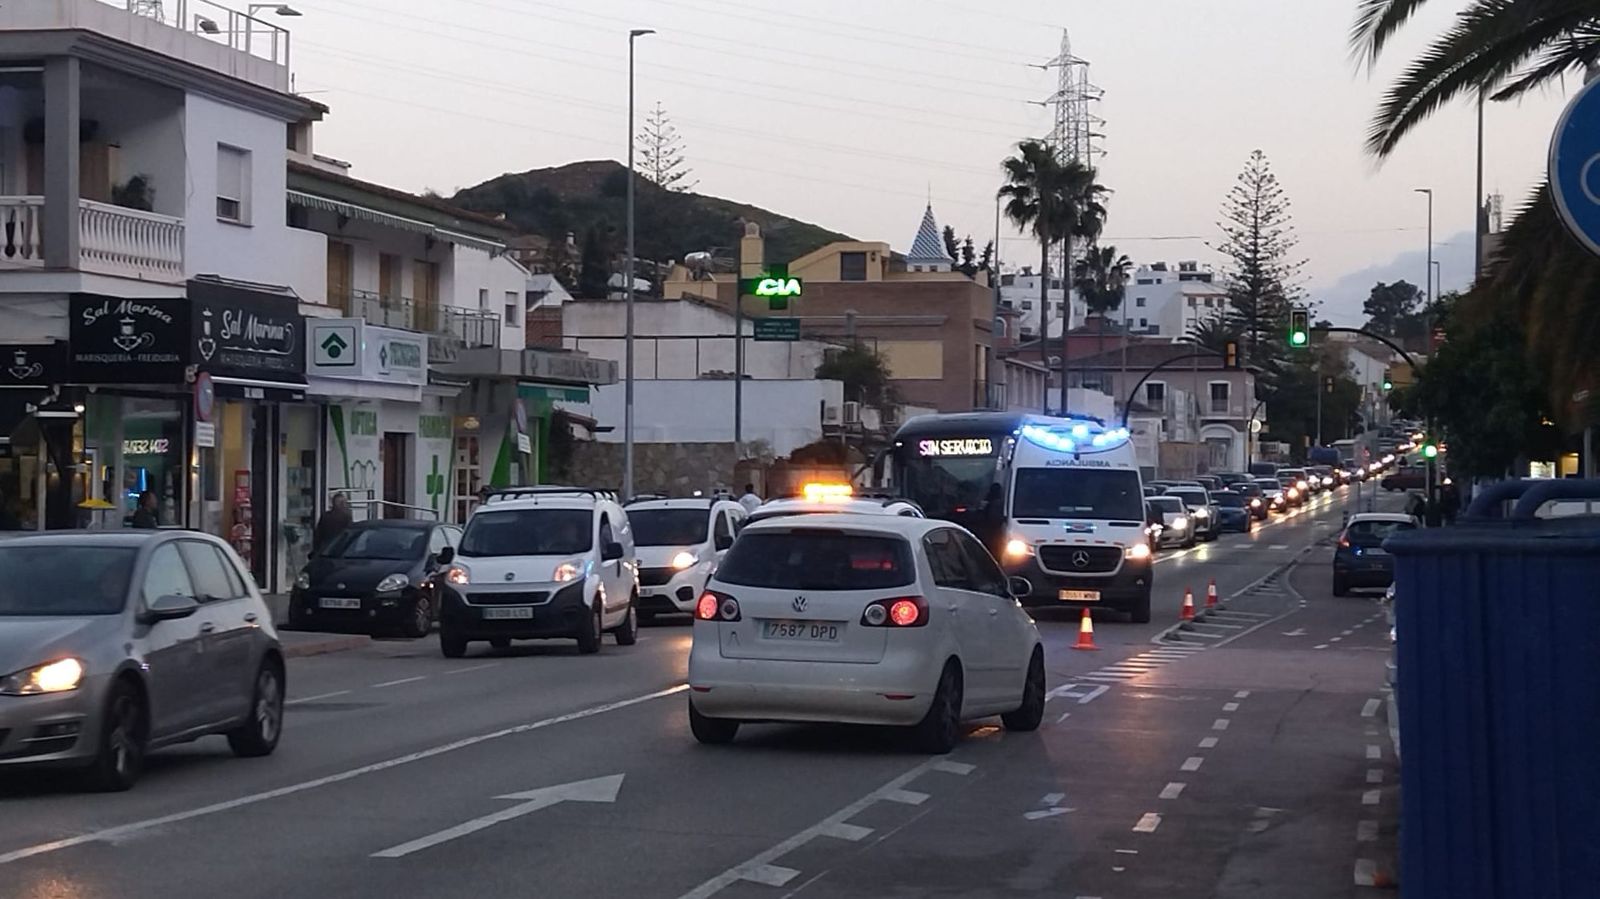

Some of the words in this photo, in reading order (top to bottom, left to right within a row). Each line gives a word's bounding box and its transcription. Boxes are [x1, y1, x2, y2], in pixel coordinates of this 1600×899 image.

[82, 300, 109, 325] Sal
[113, 299, 173, 324] Marina
[220, 309, 243, 340] Sal
[243, 313, 285, 345] Marina
[919, 439, 941, 455] SIN
[940, 438, 992, 455] SERVICIO
[771, 622, 807, 637] 7587
